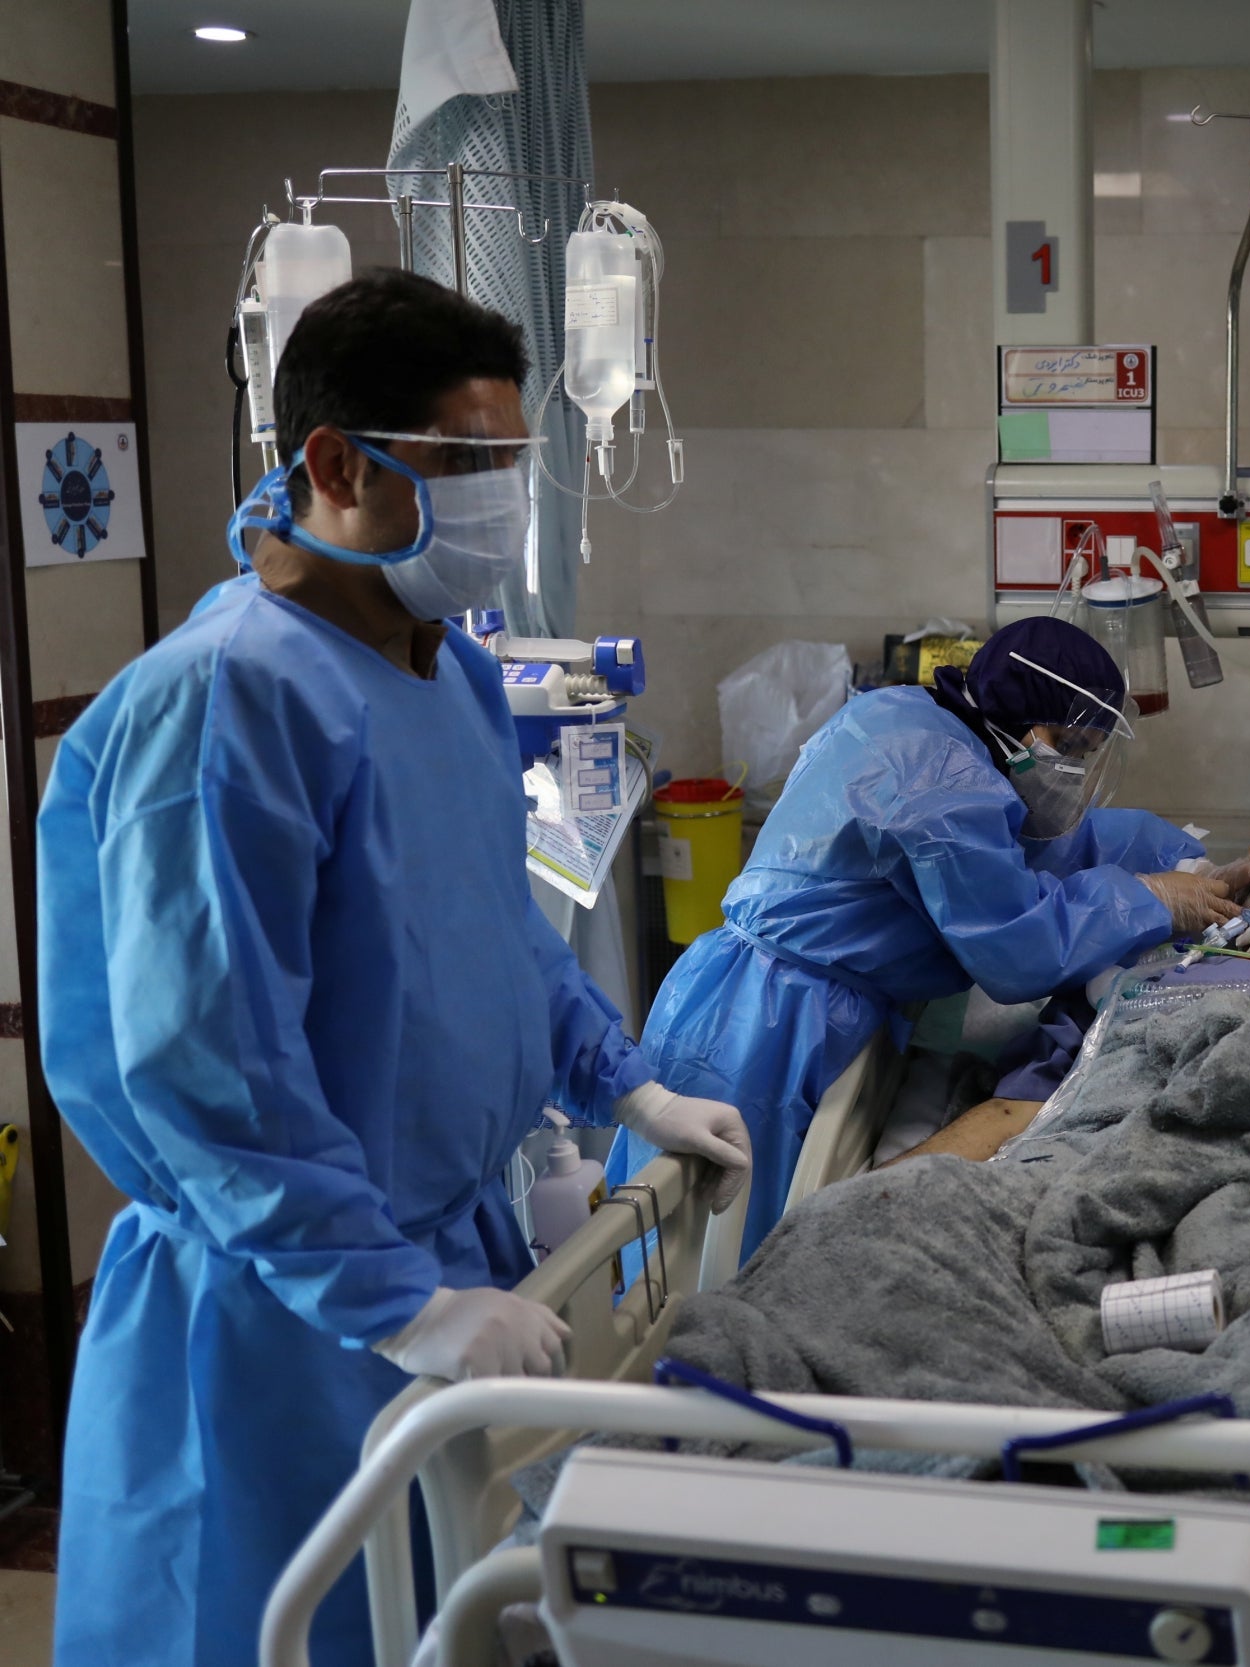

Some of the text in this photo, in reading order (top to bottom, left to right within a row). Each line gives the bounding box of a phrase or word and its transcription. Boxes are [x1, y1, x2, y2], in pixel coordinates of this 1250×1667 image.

[1031, 243, 1052, 285] 1
[1126, 371, 1137, 386] 1
[1118, 388, 1145, 398] ICU3
[680, 1574, 787, 1602] nimbus
